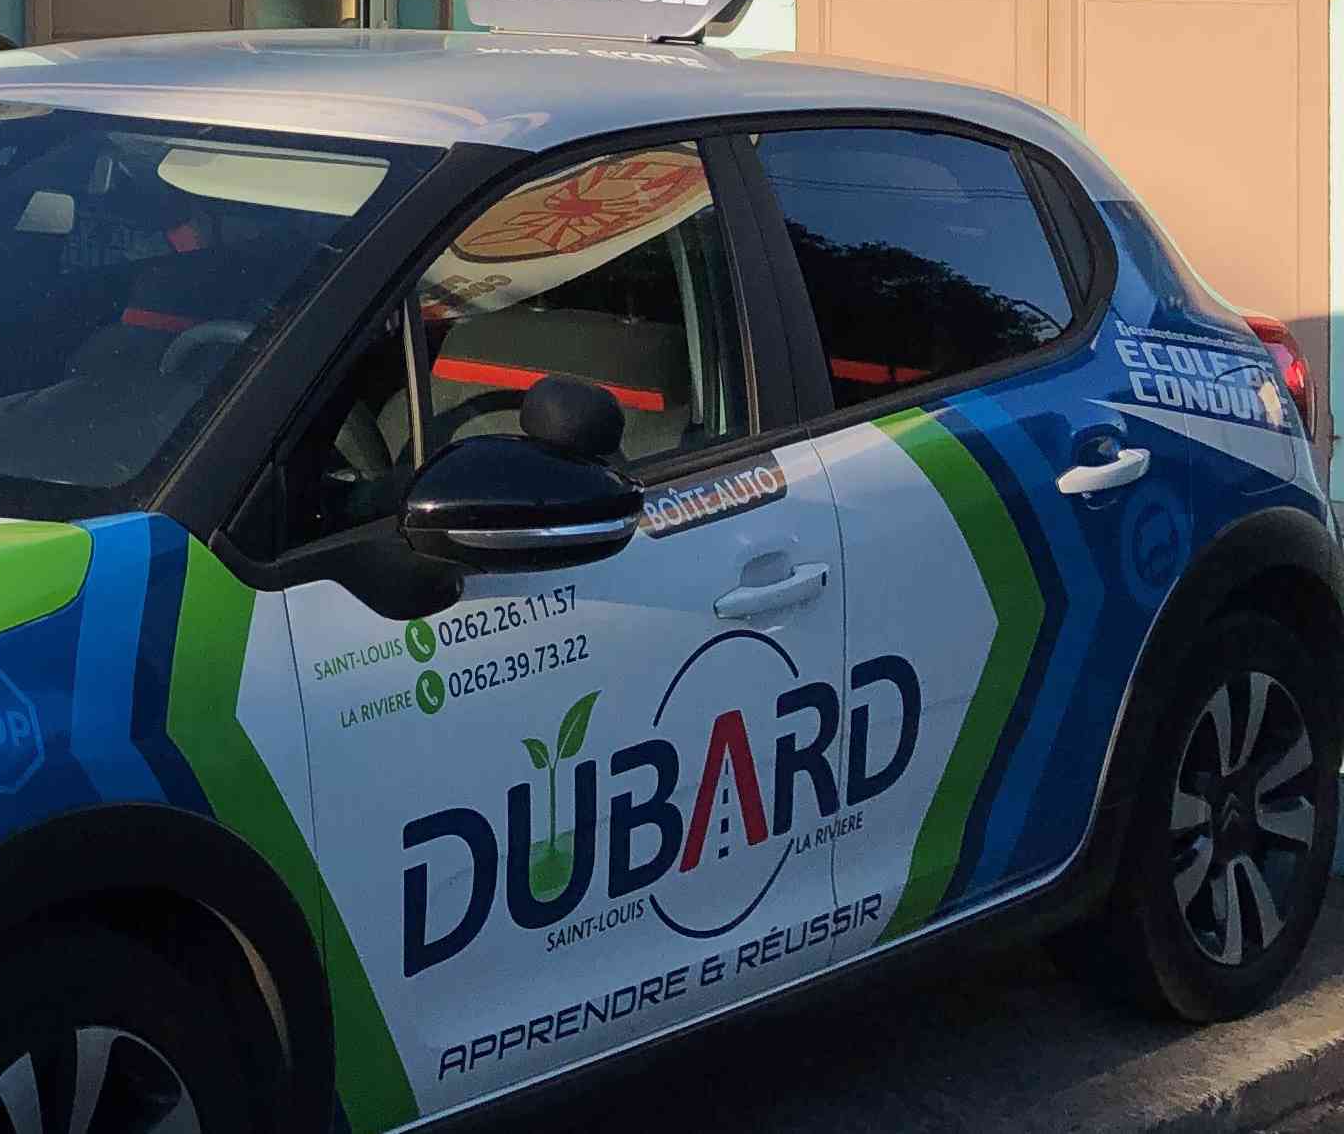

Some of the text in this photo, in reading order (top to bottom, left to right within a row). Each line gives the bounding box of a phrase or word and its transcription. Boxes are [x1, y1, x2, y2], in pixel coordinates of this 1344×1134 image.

[1115, 338, 1236, 382] ECOLE
[313, 585, 577, 680] SAINT-LOUIS 0262.26.11.57
[340, 634, 590, 728] LA RIVIERE 0262.39.73.22
[403, 653, 922, 978] DUBARD
[795, 810, 864, 855] LA RIVIERE
[545, 898, 645, 953] SAINT-LOUIS
[438, 892, 882, 1081] APPRENDRE & RÉUSSIR
